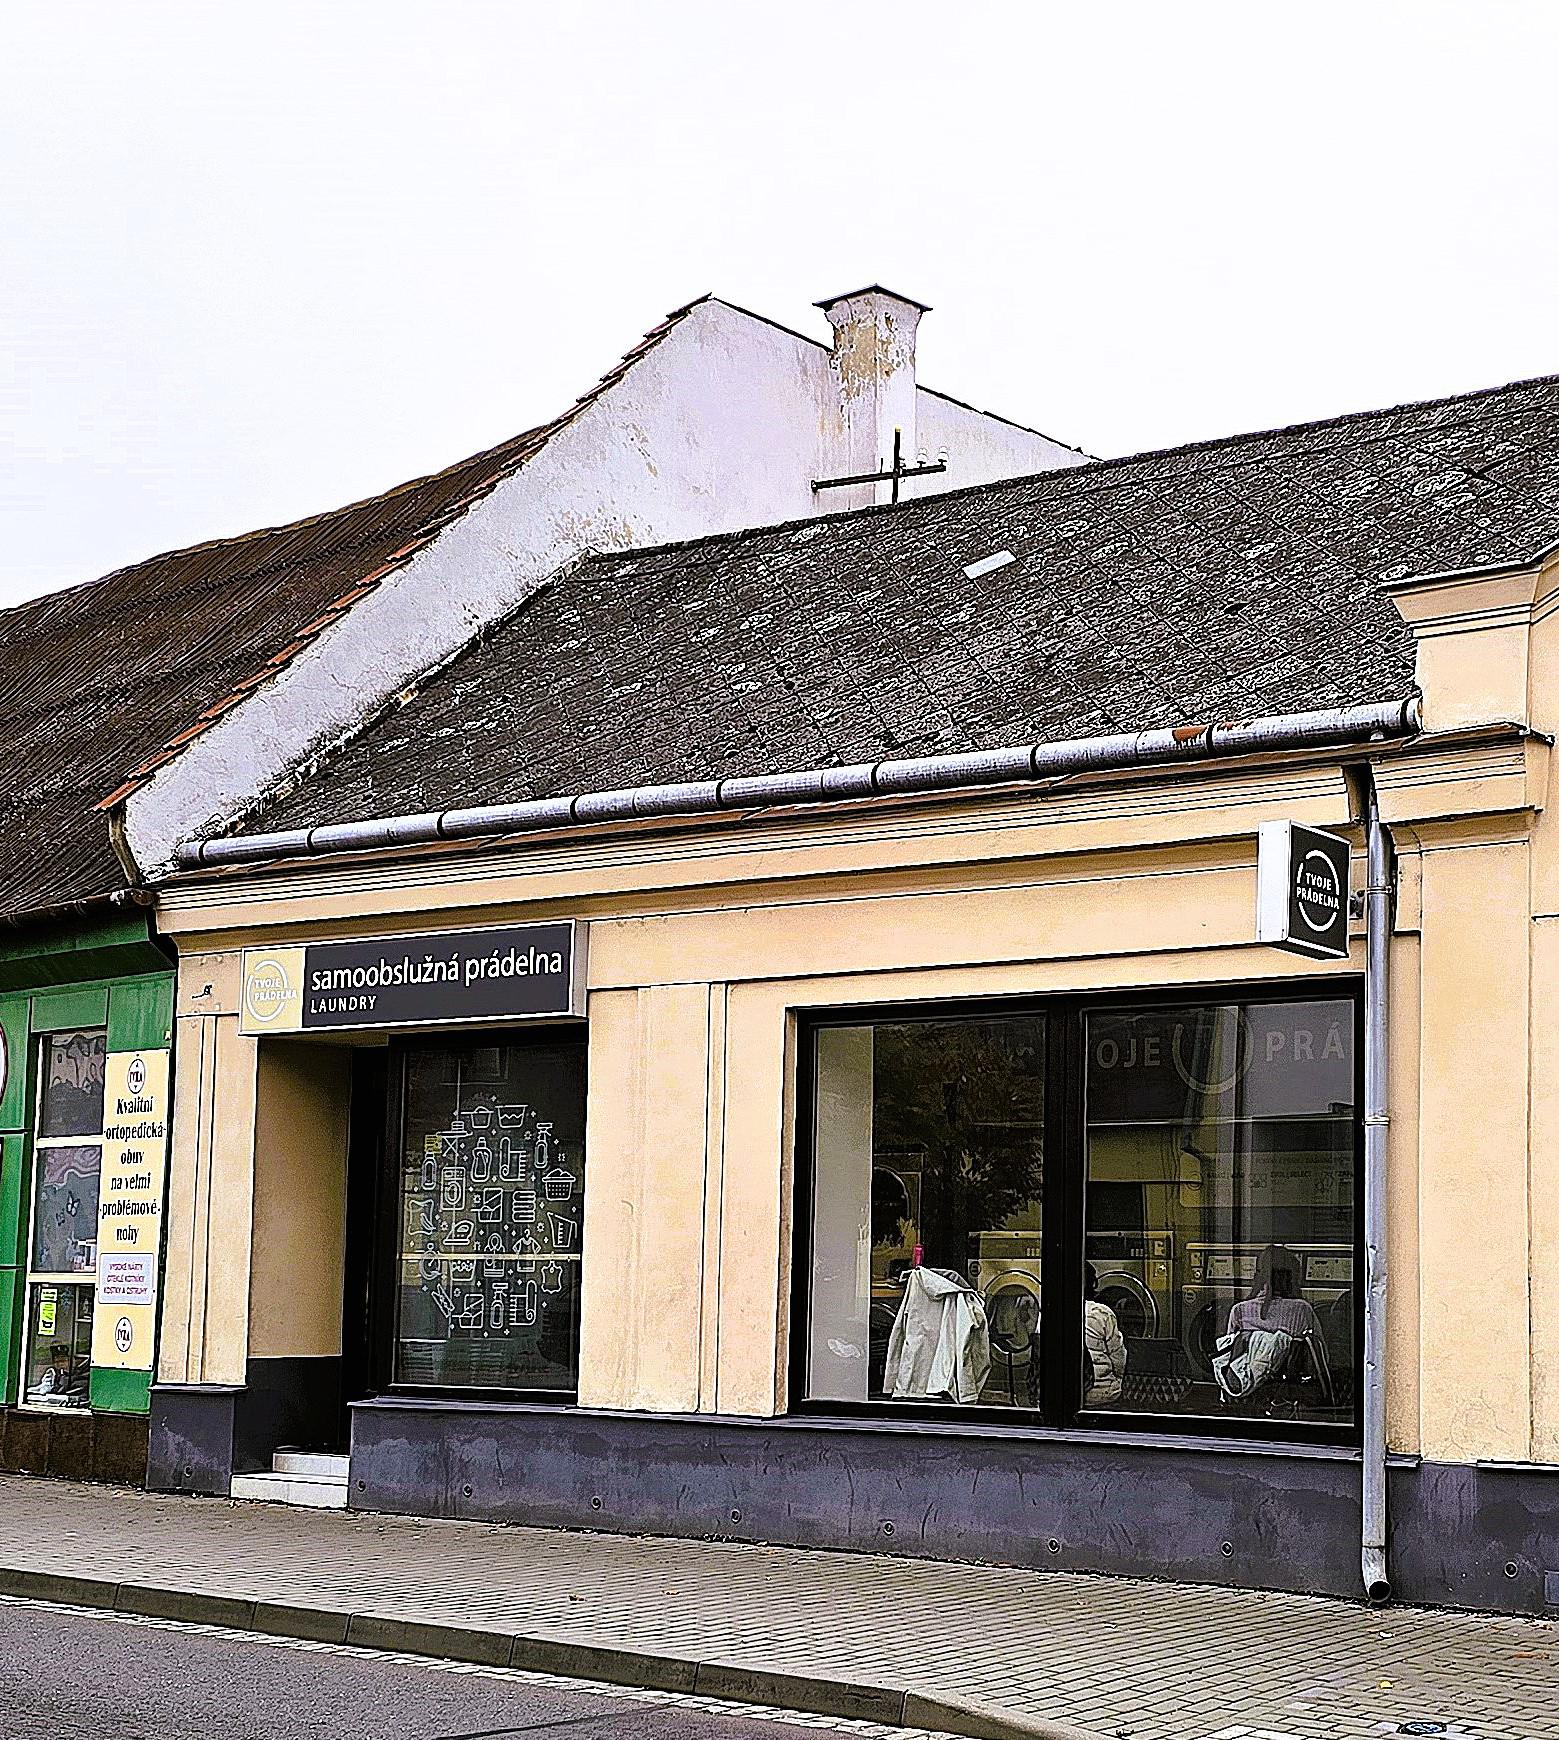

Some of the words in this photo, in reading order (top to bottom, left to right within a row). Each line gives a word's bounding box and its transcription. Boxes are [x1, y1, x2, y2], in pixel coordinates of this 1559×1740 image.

[1305, 872, 1332, 891] TVOJE
[1296, 886, 1340, 910] PRÁDELNA
[311, 953, 459, 991] samoobslužná
[465, 946, 563, 987] prádelna
[254, 977, 281, 989] TVOJE
[254, 989, 298, 1002] PRÁDELNA
[310, 995, 377, 1015] LAUNDRY
[116, 1096, 154, 1114] Kvalitní
[105, 1121, 163, 1142] ortopedická
[120, 1148, 145, 1165] obuv
[111, 1176, 122, 1191] na
[102, 1198, 158, 1220] problémové
[116, 1224, 140, 1244] nohy
